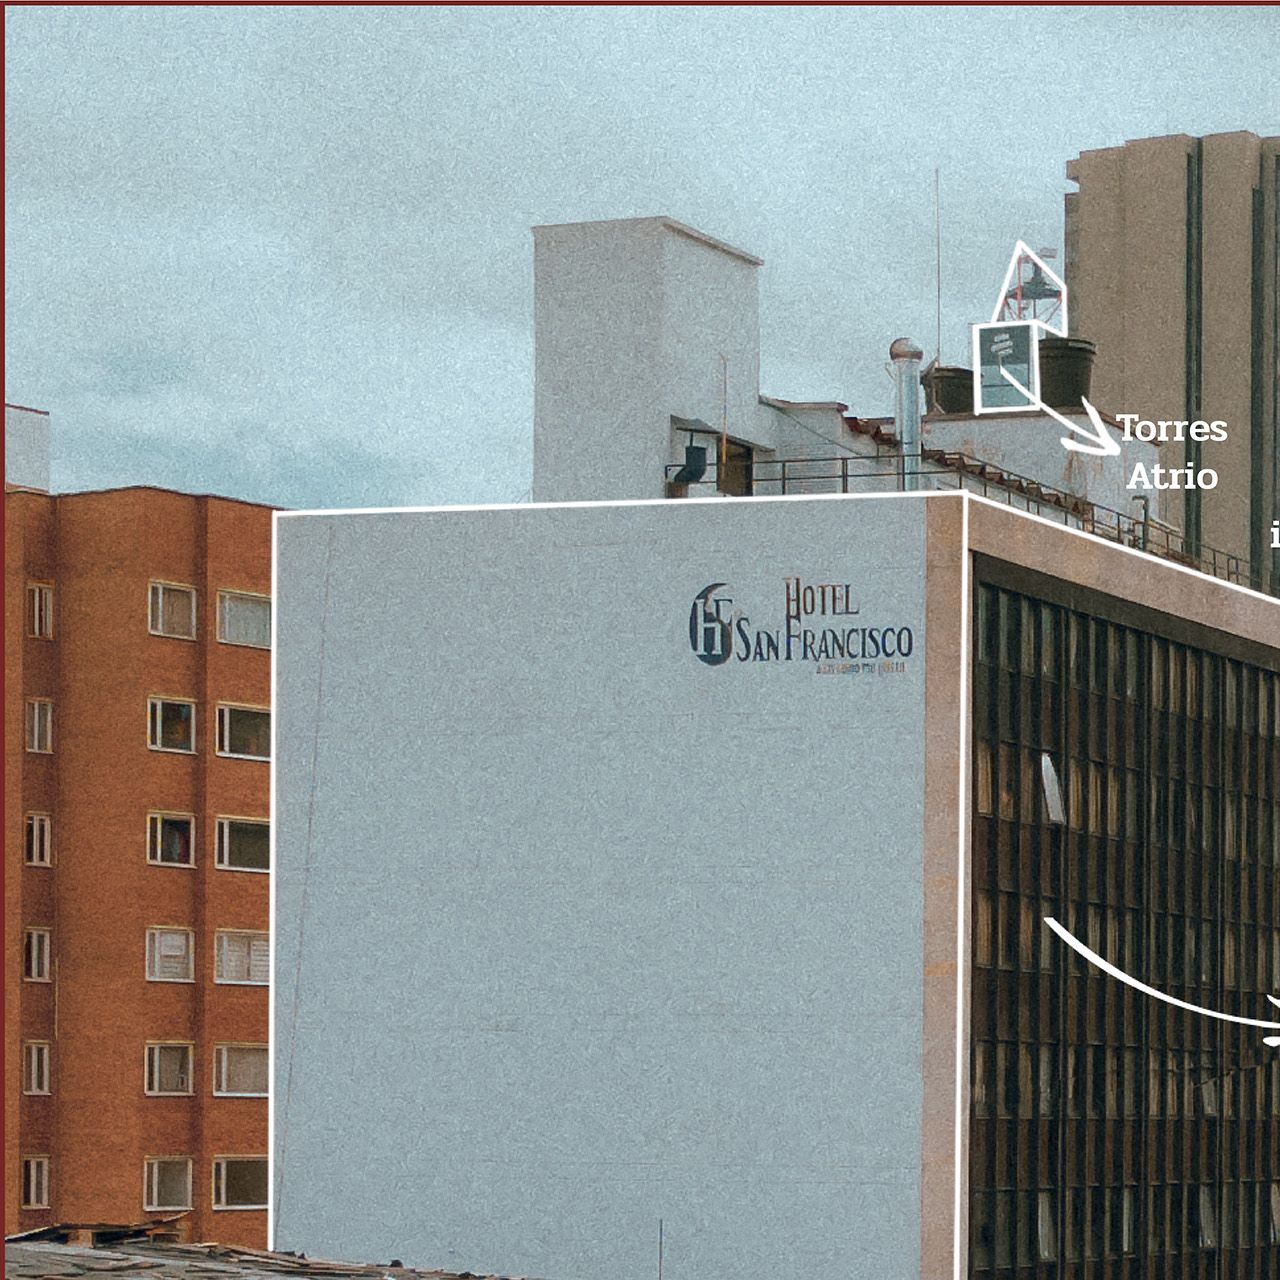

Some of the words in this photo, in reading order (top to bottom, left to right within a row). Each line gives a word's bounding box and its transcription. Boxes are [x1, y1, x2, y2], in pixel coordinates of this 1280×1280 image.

[784, 577, 859, 617] HOTEL
[736, 617, 780, 662] SAN
[785, 615, 914, 662] FRANCISCO
